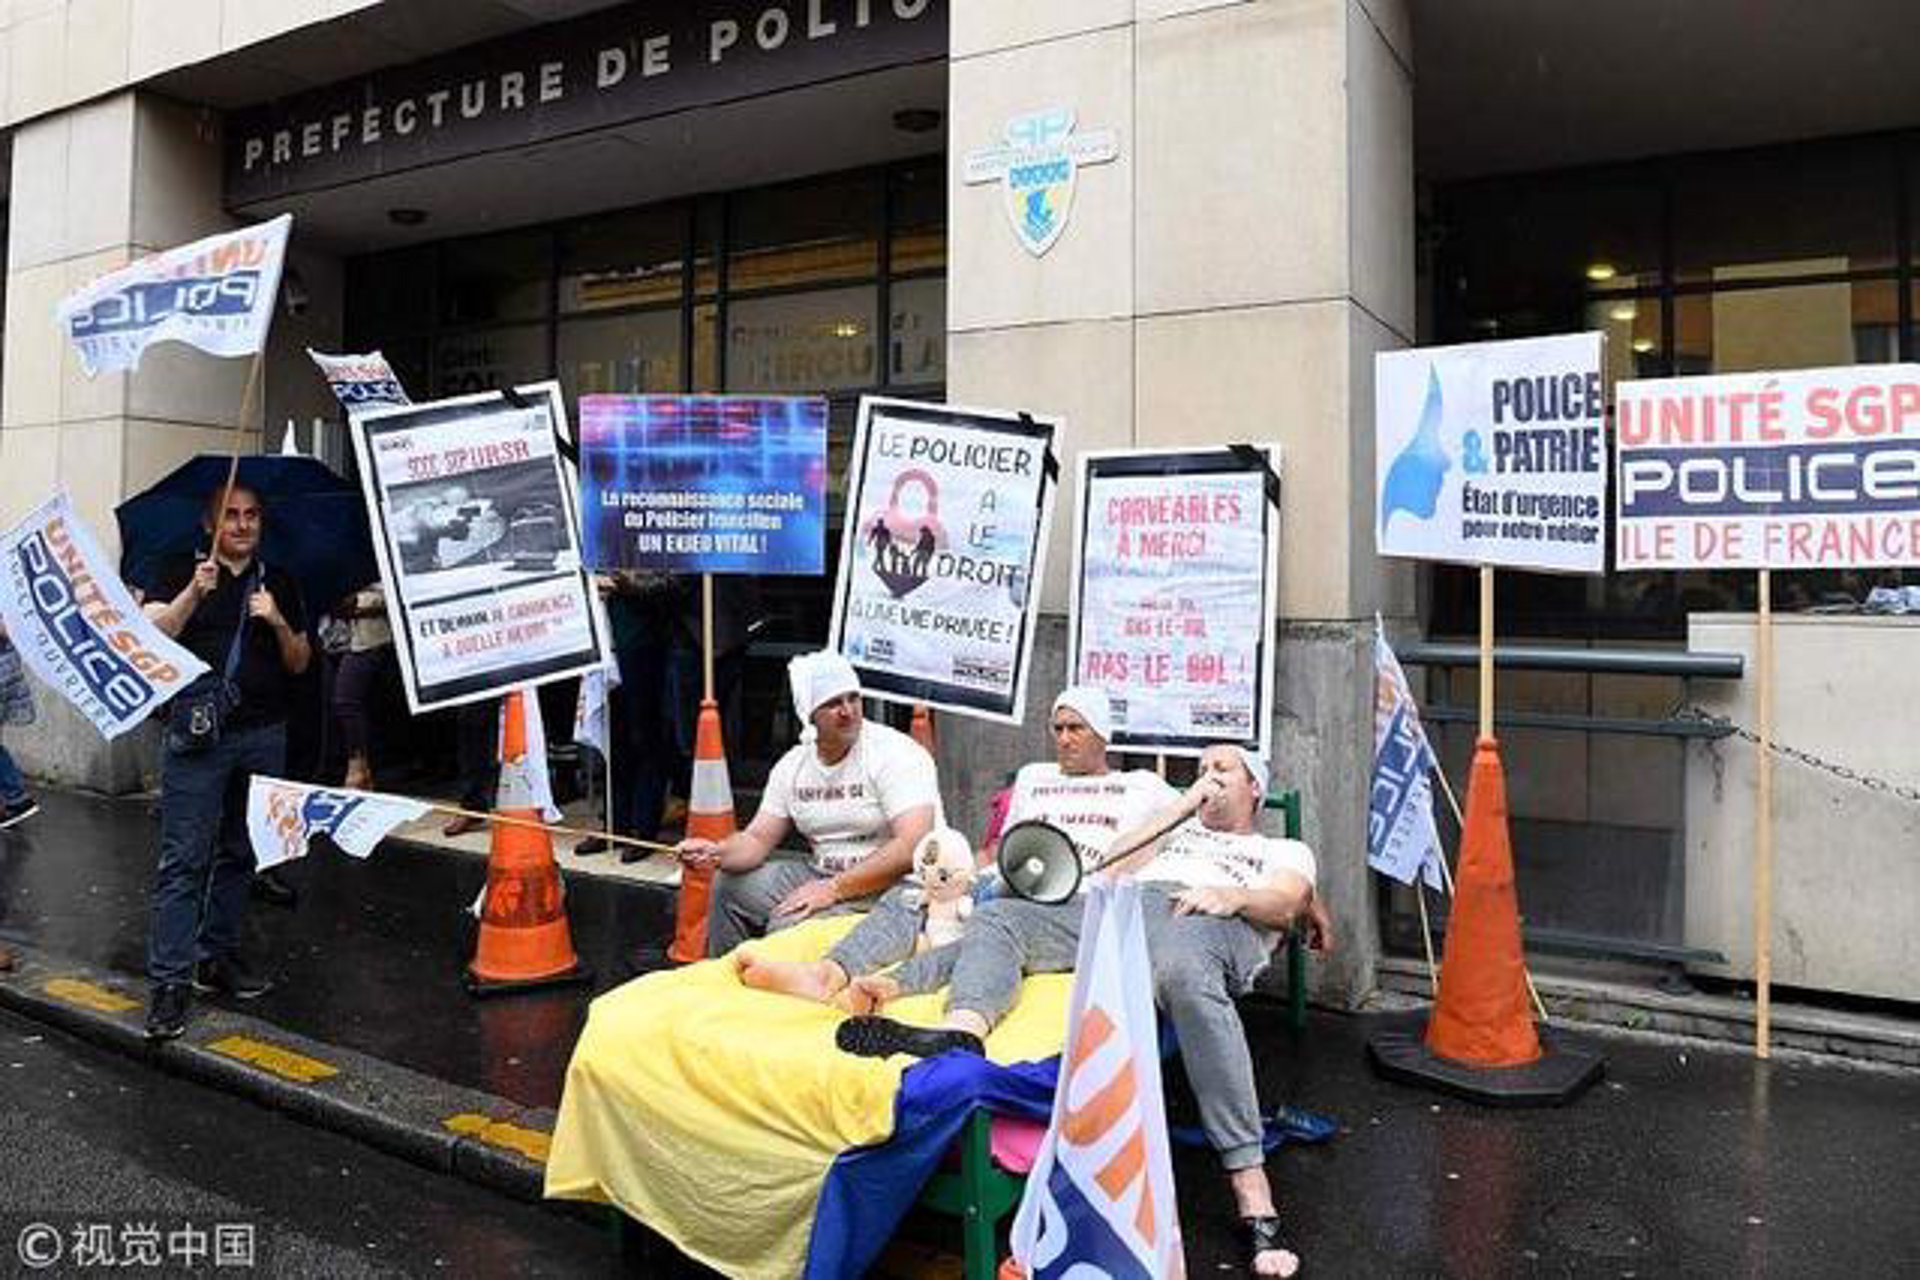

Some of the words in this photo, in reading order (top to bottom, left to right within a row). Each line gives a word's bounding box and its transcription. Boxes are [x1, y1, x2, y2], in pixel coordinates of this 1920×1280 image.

[243, 62, 564, 170] PREFECTURE
[597, 35, 671, 89] DE
[1493, 371, 1603, 424] POLICE
[1619, 379, 1787, 446] UNITÉ
[1805, 383, 1920, 438] SGP
[877, 432, 909, 459] LE
[909, 436, 1033, 477] POLICIER
[1461, 429, 1488, 474] &
[1492, 426, 1600, 474] PATRIE
[1623, 449, 1920, 506] POLICE
[645, 510, 706, 529] Policier
[1462, 481, 1500, 514] État
[1502, 488, 1600, 520] d'urgence
[638, 534, 662, 553] UN
[714, 534, 759, 554] VITAL
[968, 523, 998, 550] LE
[1462, 520, 1500, 540] pour
[1502, 520, 1544, 540] notre
[1621, 523, 1676, 562] ILE
[1694, 521, 1743, 560] DE
[936, 552, 1025, 589] DROIT
[20, 532, 146, 712] POLICE
[899, 606, 932, 630] VIE
[107, 629, 182, 685] SGP
